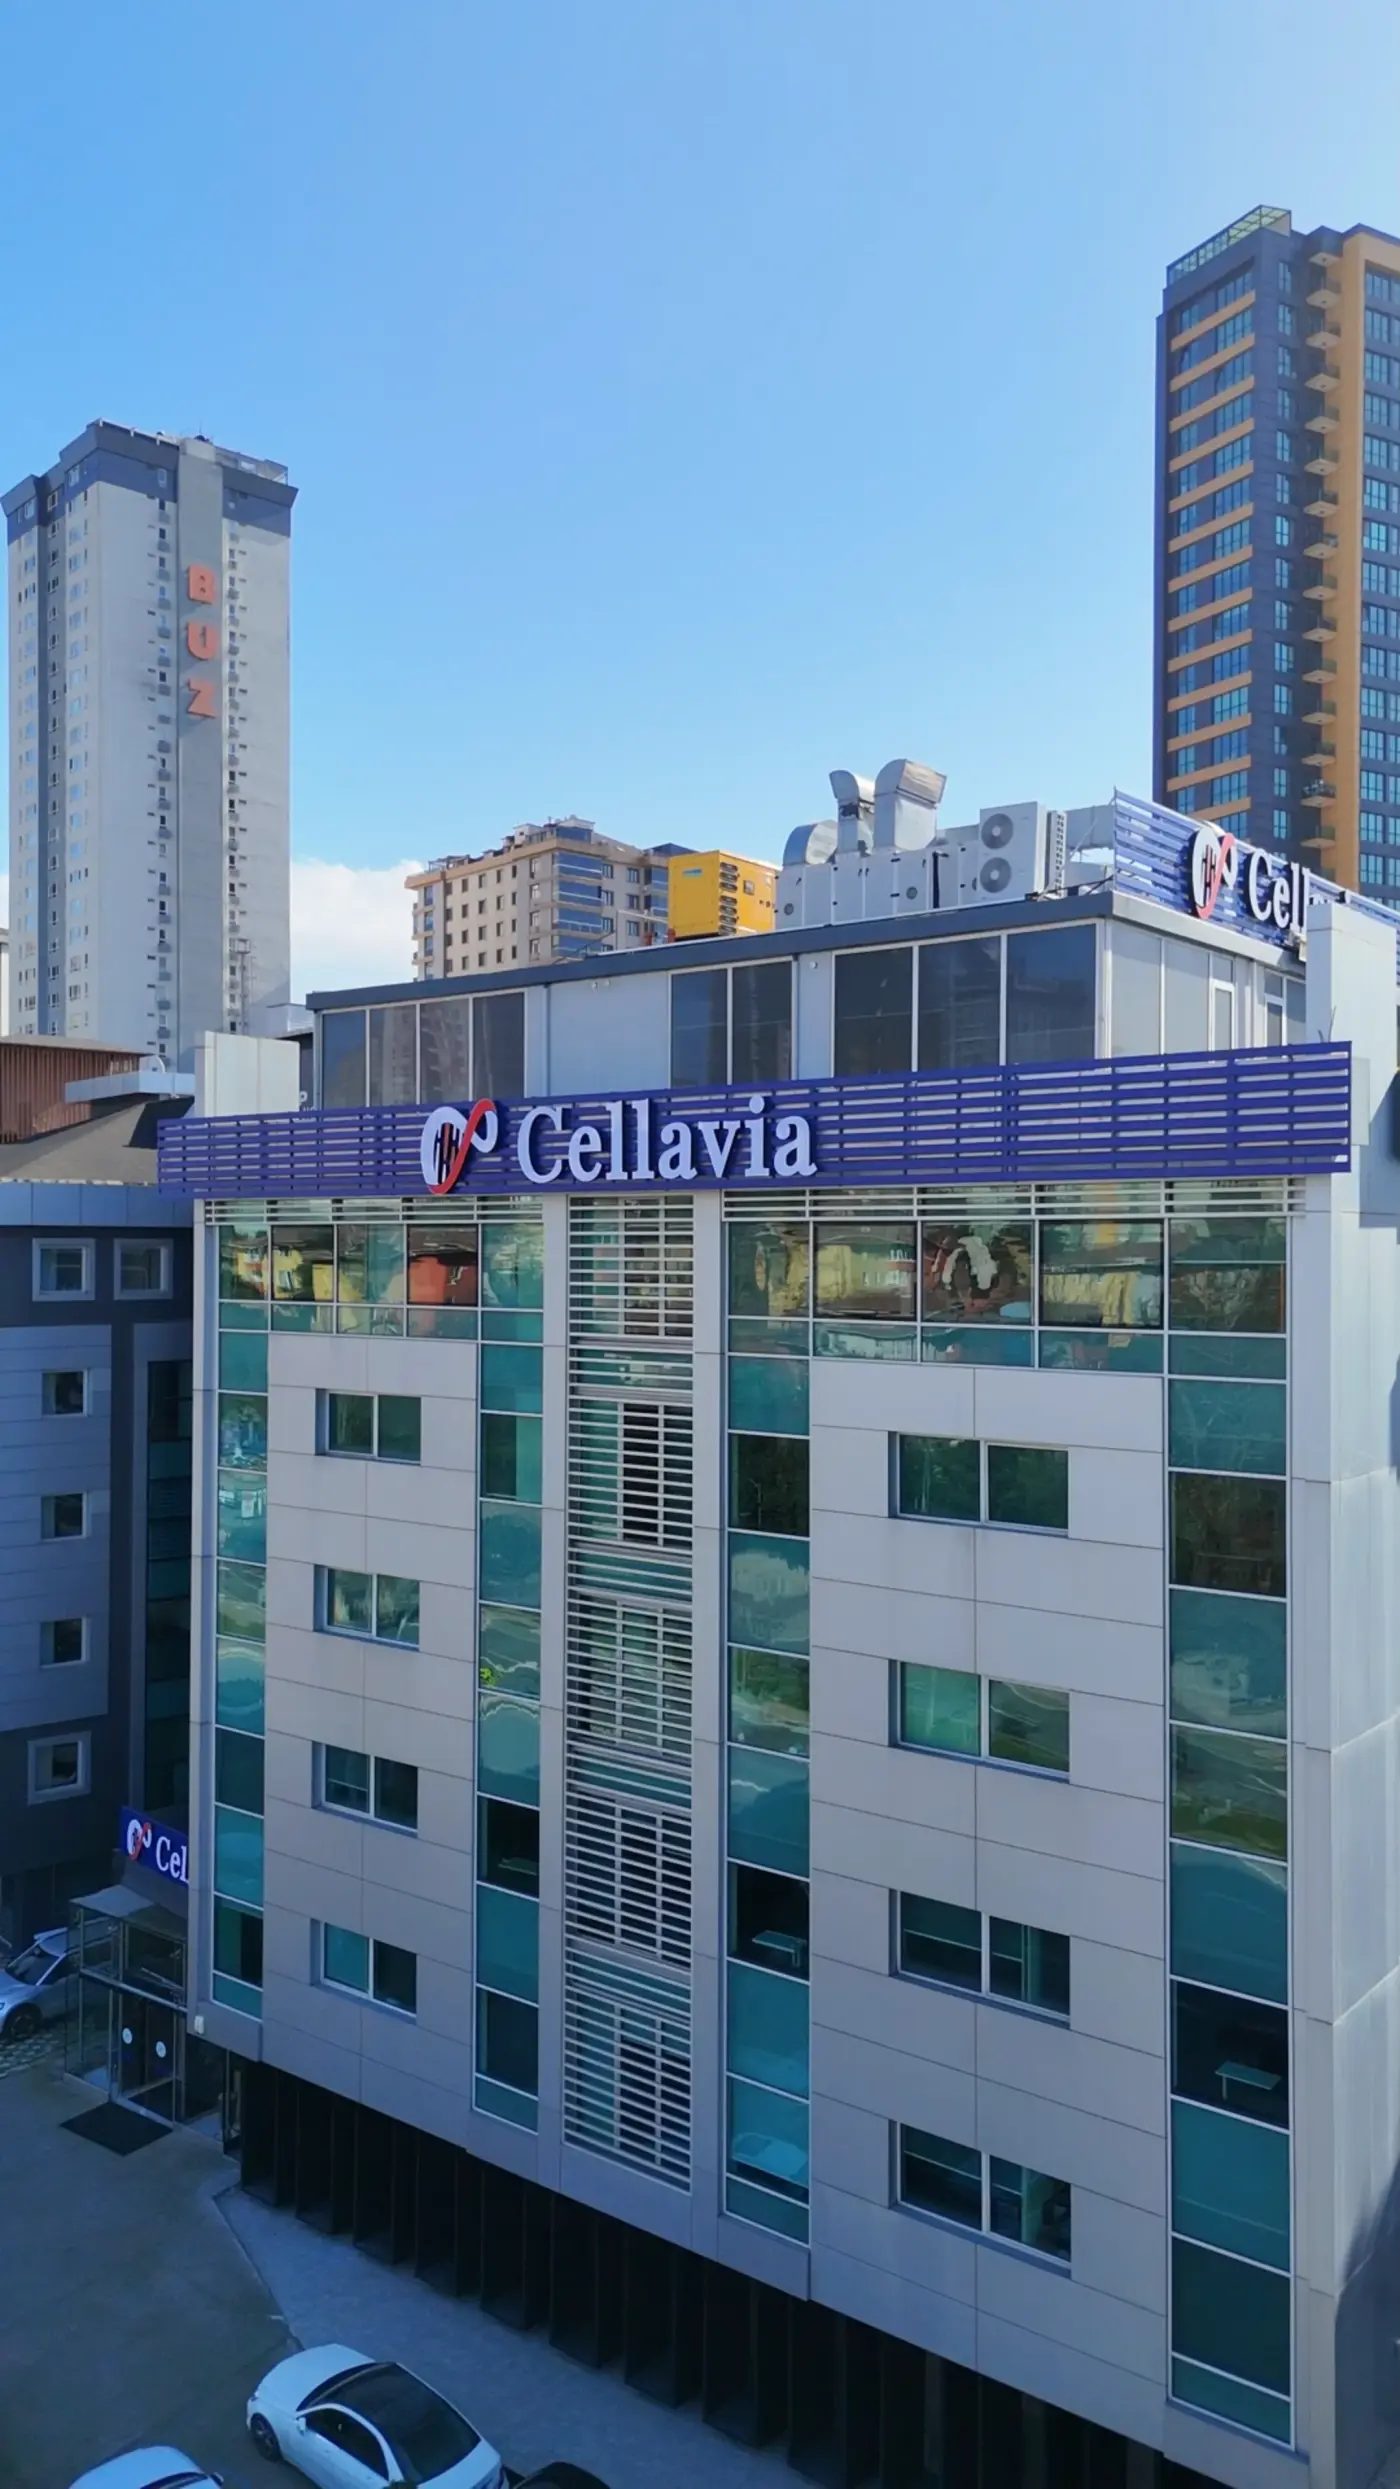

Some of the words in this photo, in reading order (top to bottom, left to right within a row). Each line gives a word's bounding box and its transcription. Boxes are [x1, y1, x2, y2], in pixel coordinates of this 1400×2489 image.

[186, 564, 217, 718] BUZ
[1249, 848, 1350, 936] Cell
[517, 1094, 818, 1184] Cellavia
